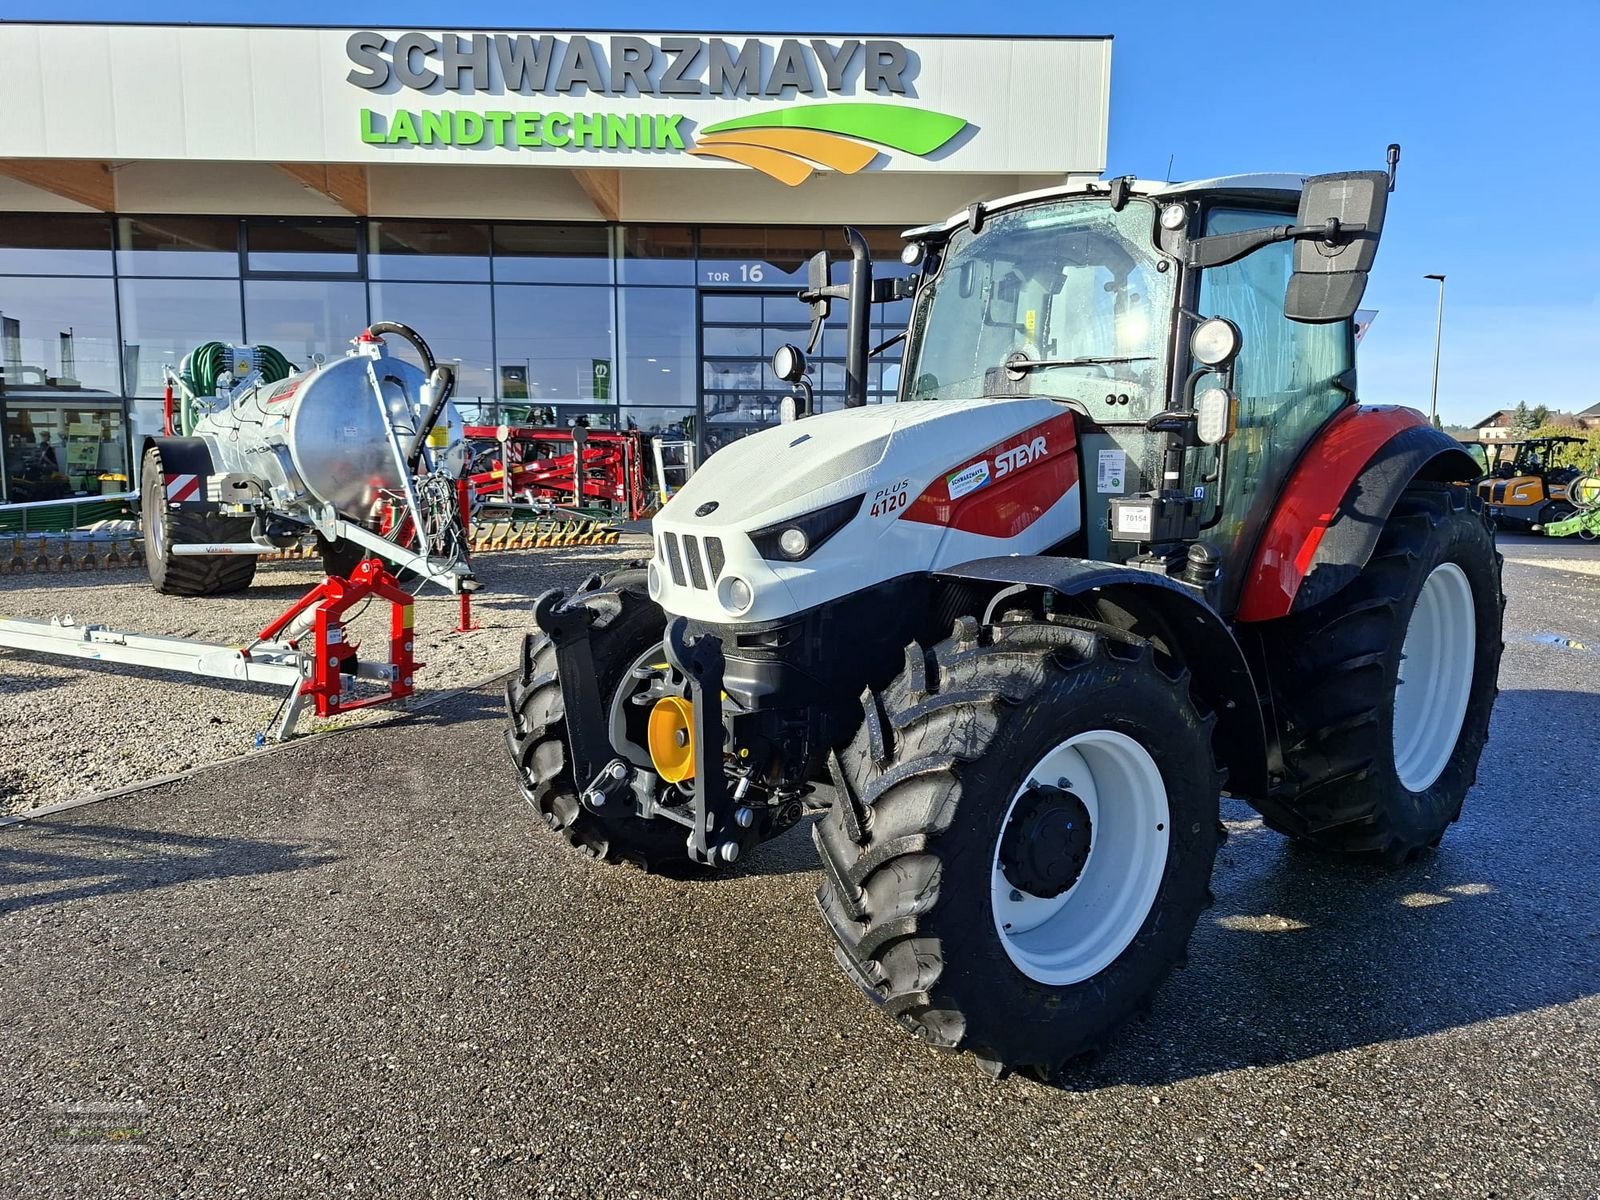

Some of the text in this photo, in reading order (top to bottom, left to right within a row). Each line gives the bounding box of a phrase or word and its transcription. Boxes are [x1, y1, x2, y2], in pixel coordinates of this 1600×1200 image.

[346, 31, 908, 97] SCHWARZMAYR
[360, 108, 686, 150] LANDTECHNIK
[707, 264, 764, 282] TOR 16
[994, 435, 1049, 479] STEYR
[875, 478, 910, 501] PLUS
[869, 491, 908, 518] 4120
[1125, 514, 1147, 522] 70154
